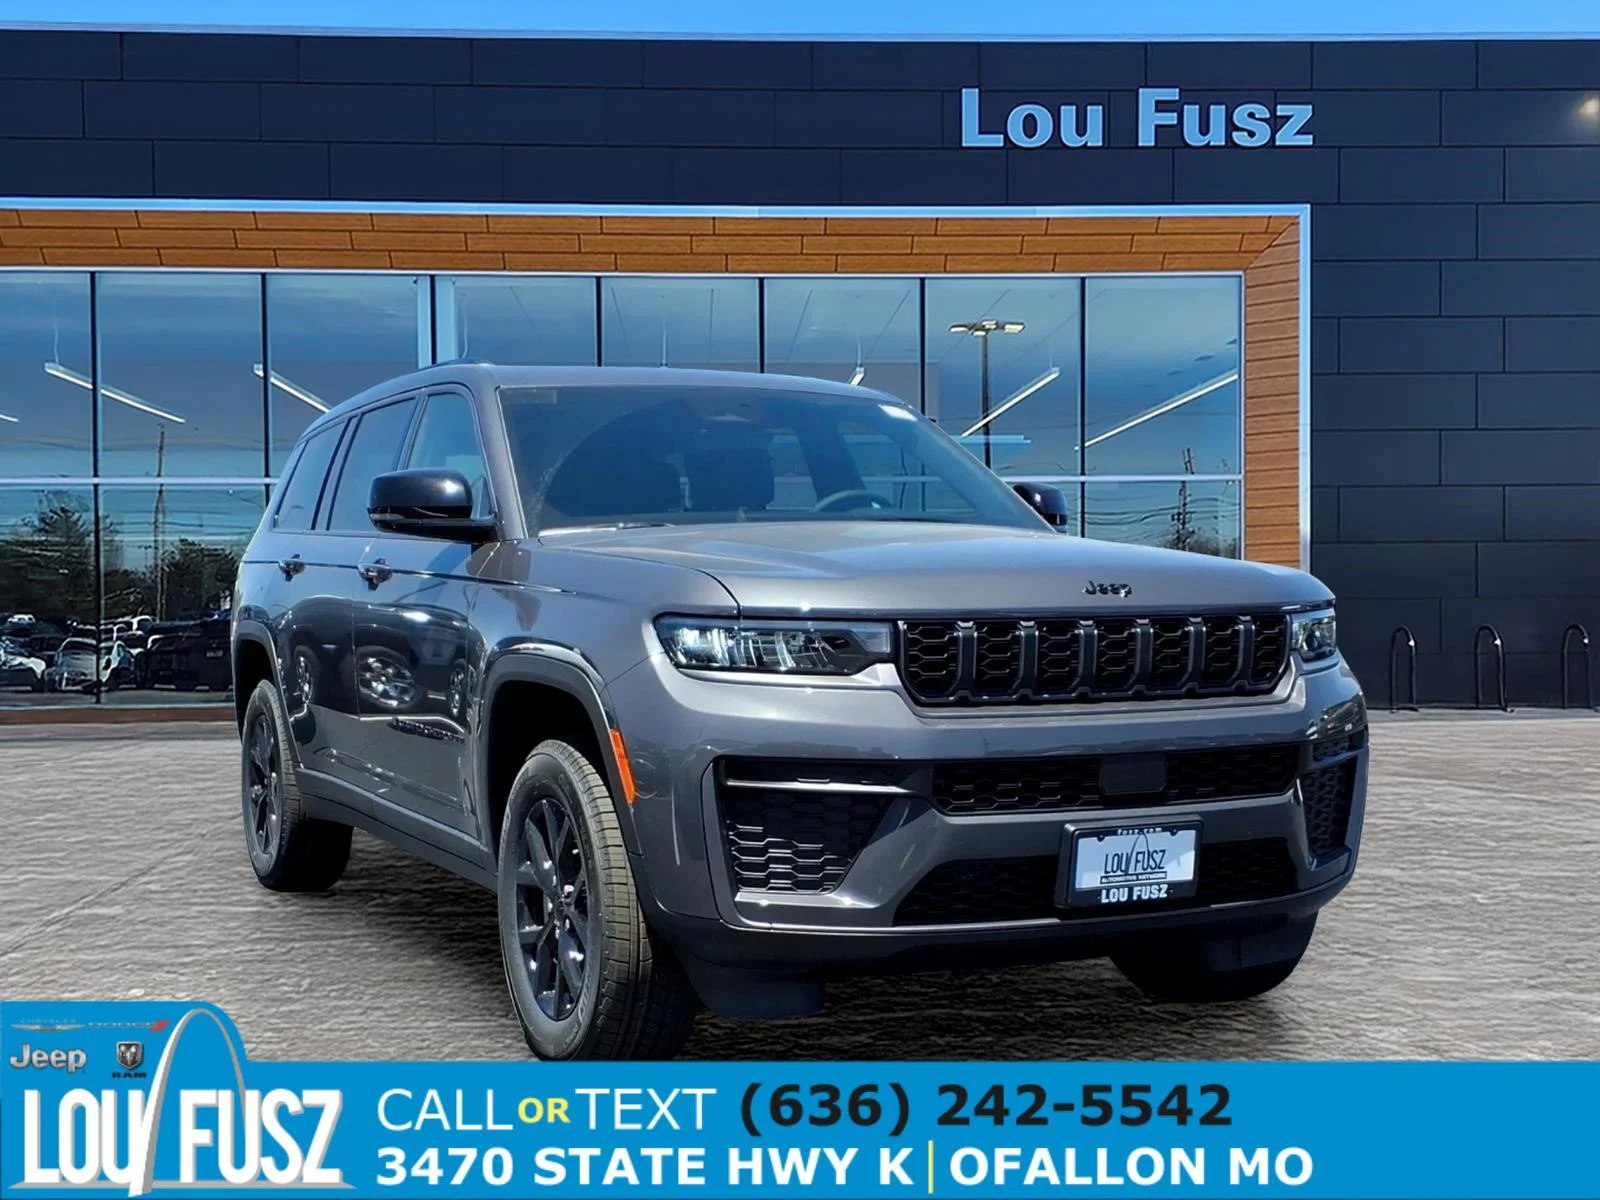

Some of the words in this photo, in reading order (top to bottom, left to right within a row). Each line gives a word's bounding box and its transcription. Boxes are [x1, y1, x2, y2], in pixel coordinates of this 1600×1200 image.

[961, 87, 1104, 148] Lou
[1138, 87, 1314, 148] Fusz
[1083, 580, 1132, 597] Jeep
[1104, 852, 1130, 875] LOU
[1134, 849, 1167, 872] FUSZ
[1101, 887, 1129, 903] LOU
[1133, 884, 1169, 901] FUSZ
